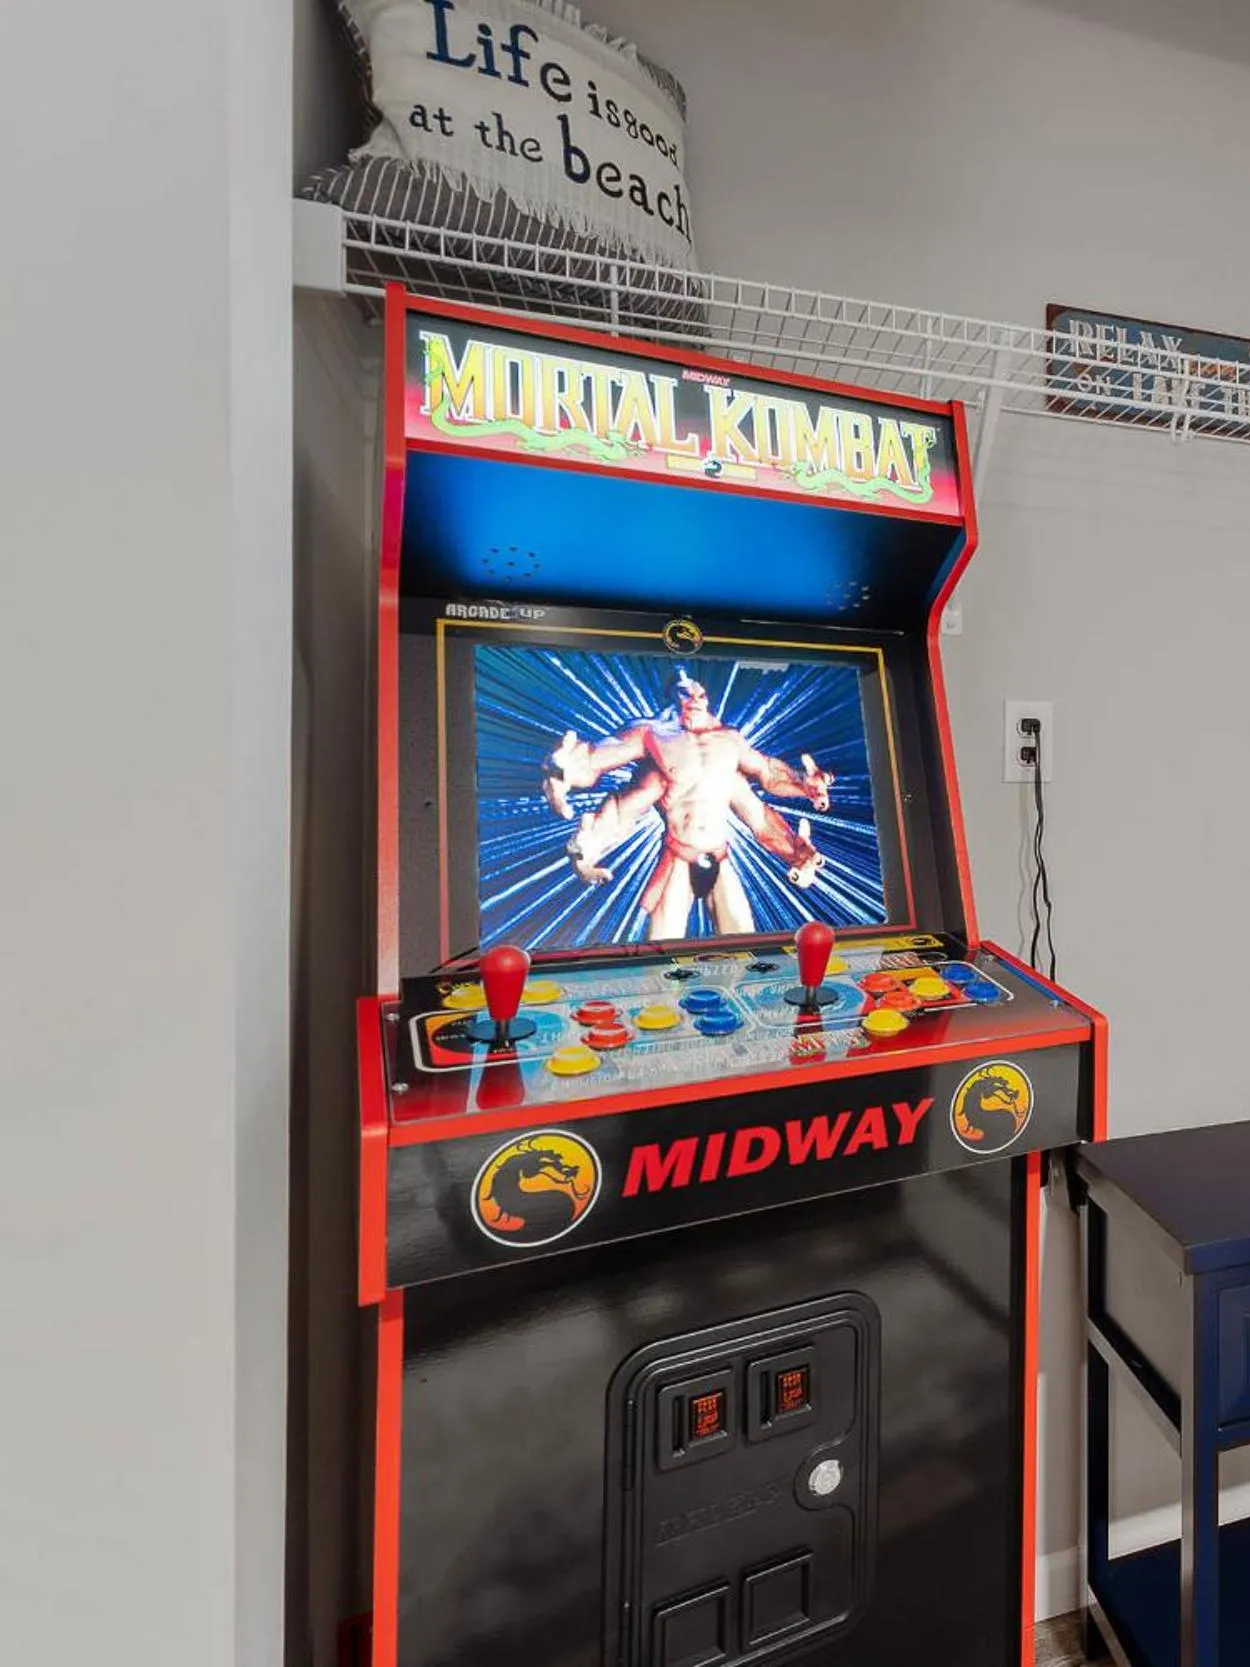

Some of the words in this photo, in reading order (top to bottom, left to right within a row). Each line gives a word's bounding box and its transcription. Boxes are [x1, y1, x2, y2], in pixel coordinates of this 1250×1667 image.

[425, 0, 572, 103] Life
[409, 104, 455, 137] at
[474, 112, 543, 163] the
[557, 113, 692, 244] beach
[419, 330, 700, 458] MORTAL
[703, 384, 937, 489] KOMBAT
[621, 1098, 935, 1198] MIDWAY
